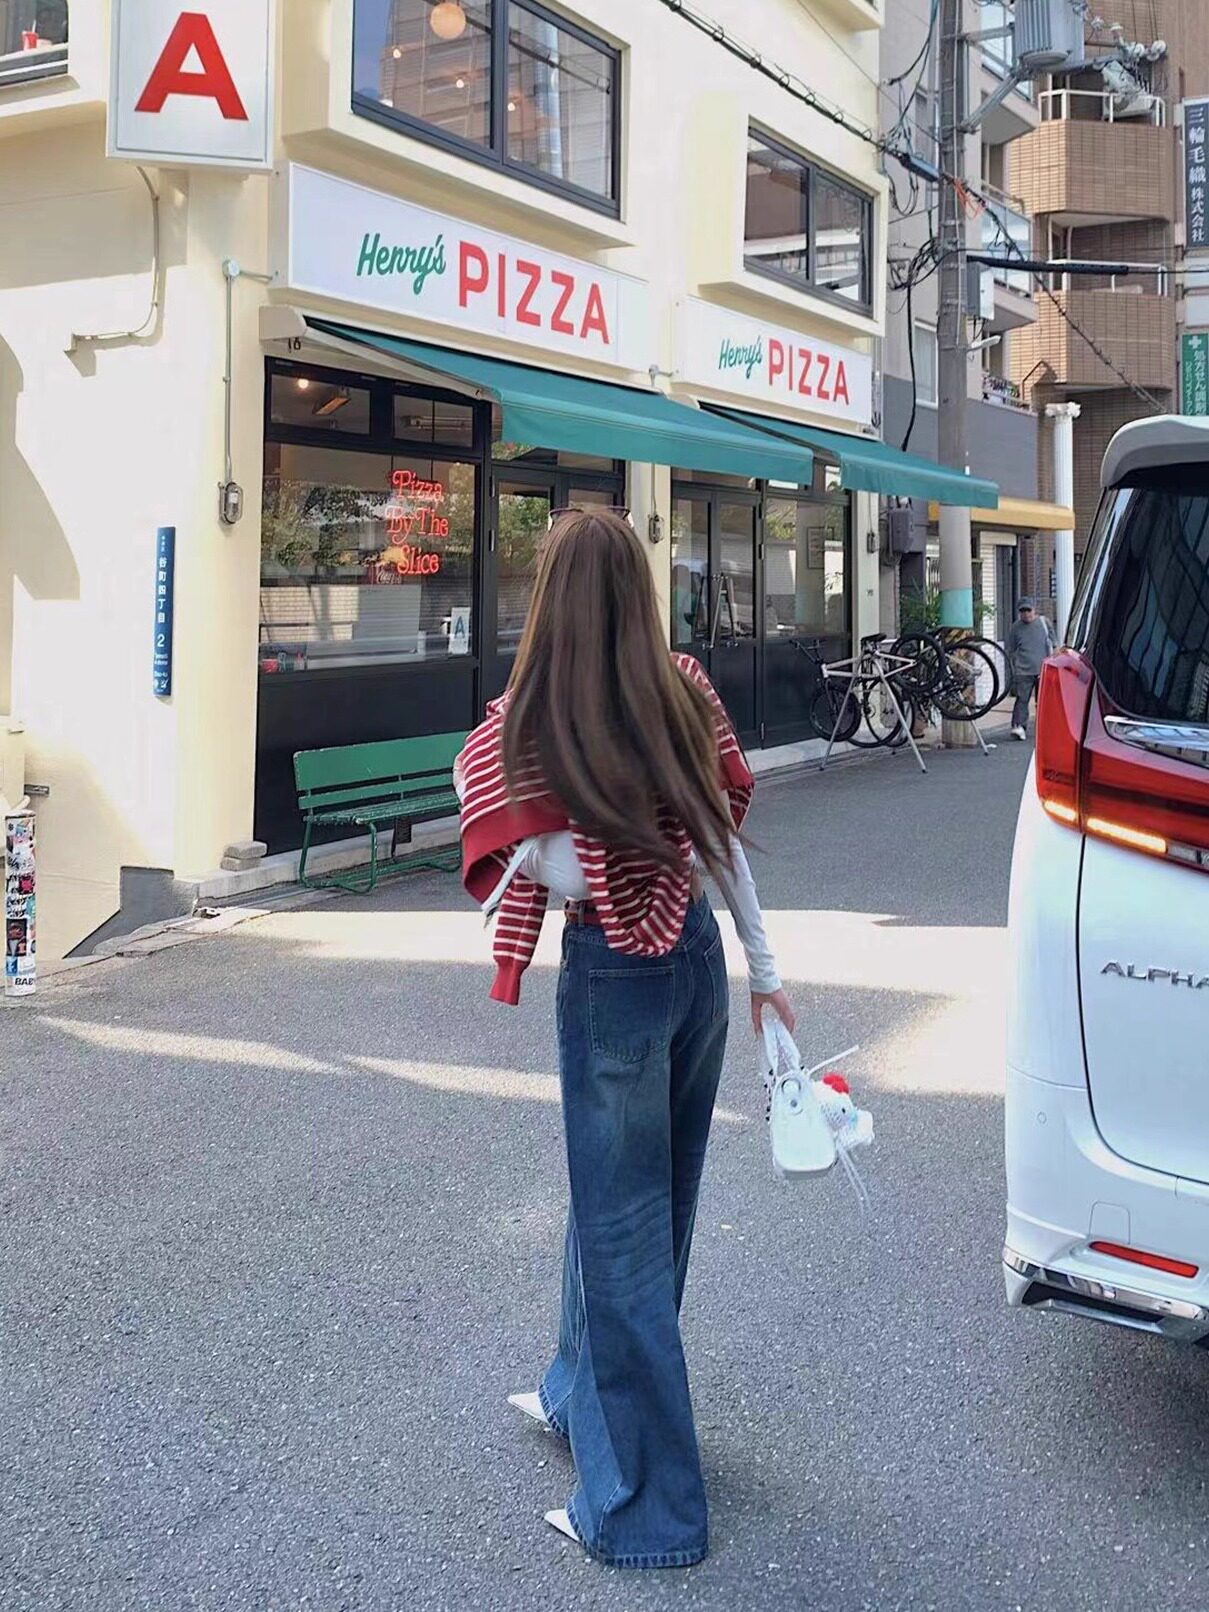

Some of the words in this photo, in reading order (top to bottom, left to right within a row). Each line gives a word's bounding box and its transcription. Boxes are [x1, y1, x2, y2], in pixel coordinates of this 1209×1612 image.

[134, 11, 249, 121] A
[356, 233, 446, 296] Henry's
[458, 240, 610, 345] PIZZA
[718, 335, 763, 379] Henry's
[768, 338, 849, 405] PIZZA
[392, 469, 444, 504] Pizza
[384, 505, 414, 544] By
[414, 506, 449, 538] The
[396, 544, 440, 575] Slice
[157, 633, 166, 648] 2
[453, 615, 466, 640] A
